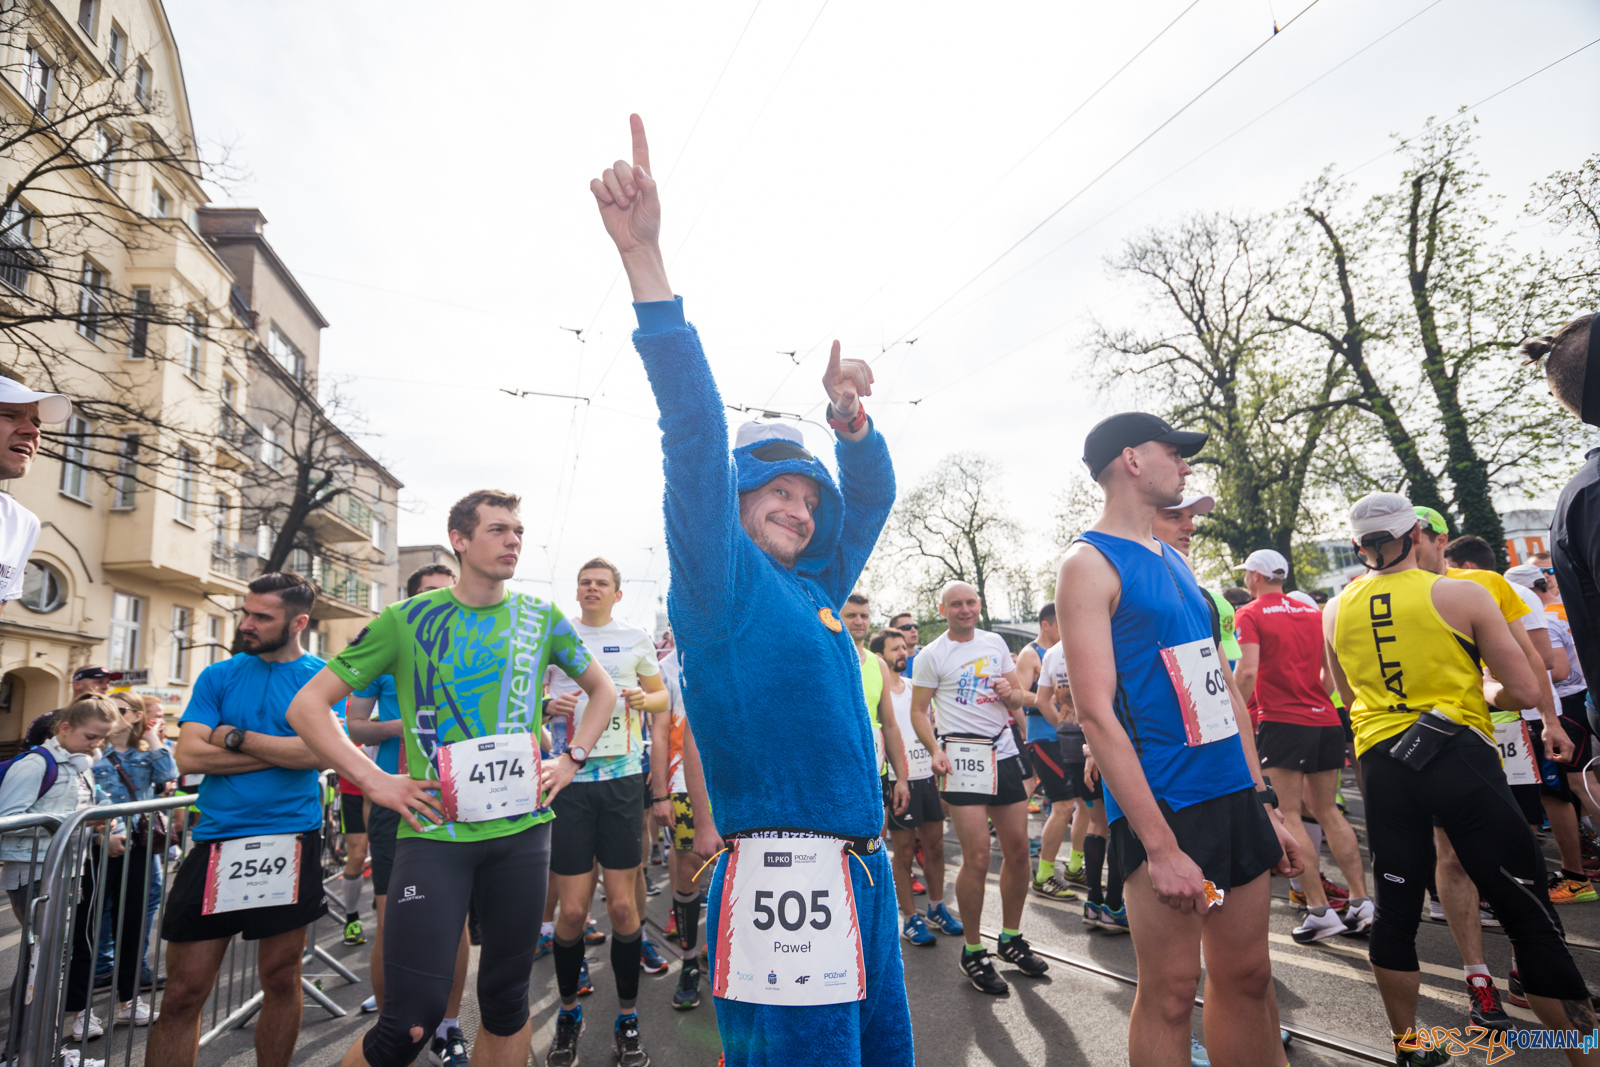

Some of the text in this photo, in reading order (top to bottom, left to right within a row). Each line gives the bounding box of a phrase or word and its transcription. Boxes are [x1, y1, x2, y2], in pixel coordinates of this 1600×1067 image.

[1205, 667, 1227, 696] 60
[469, 758, 525, 784] 4174
[954, 758, 985, 772] 1185
[489, 785, 508, 794] Jacek
[229, 857, 287, 880] 2549
[752, 889, 832, 932] 505
[774, 941, 812, 953] Paweł
